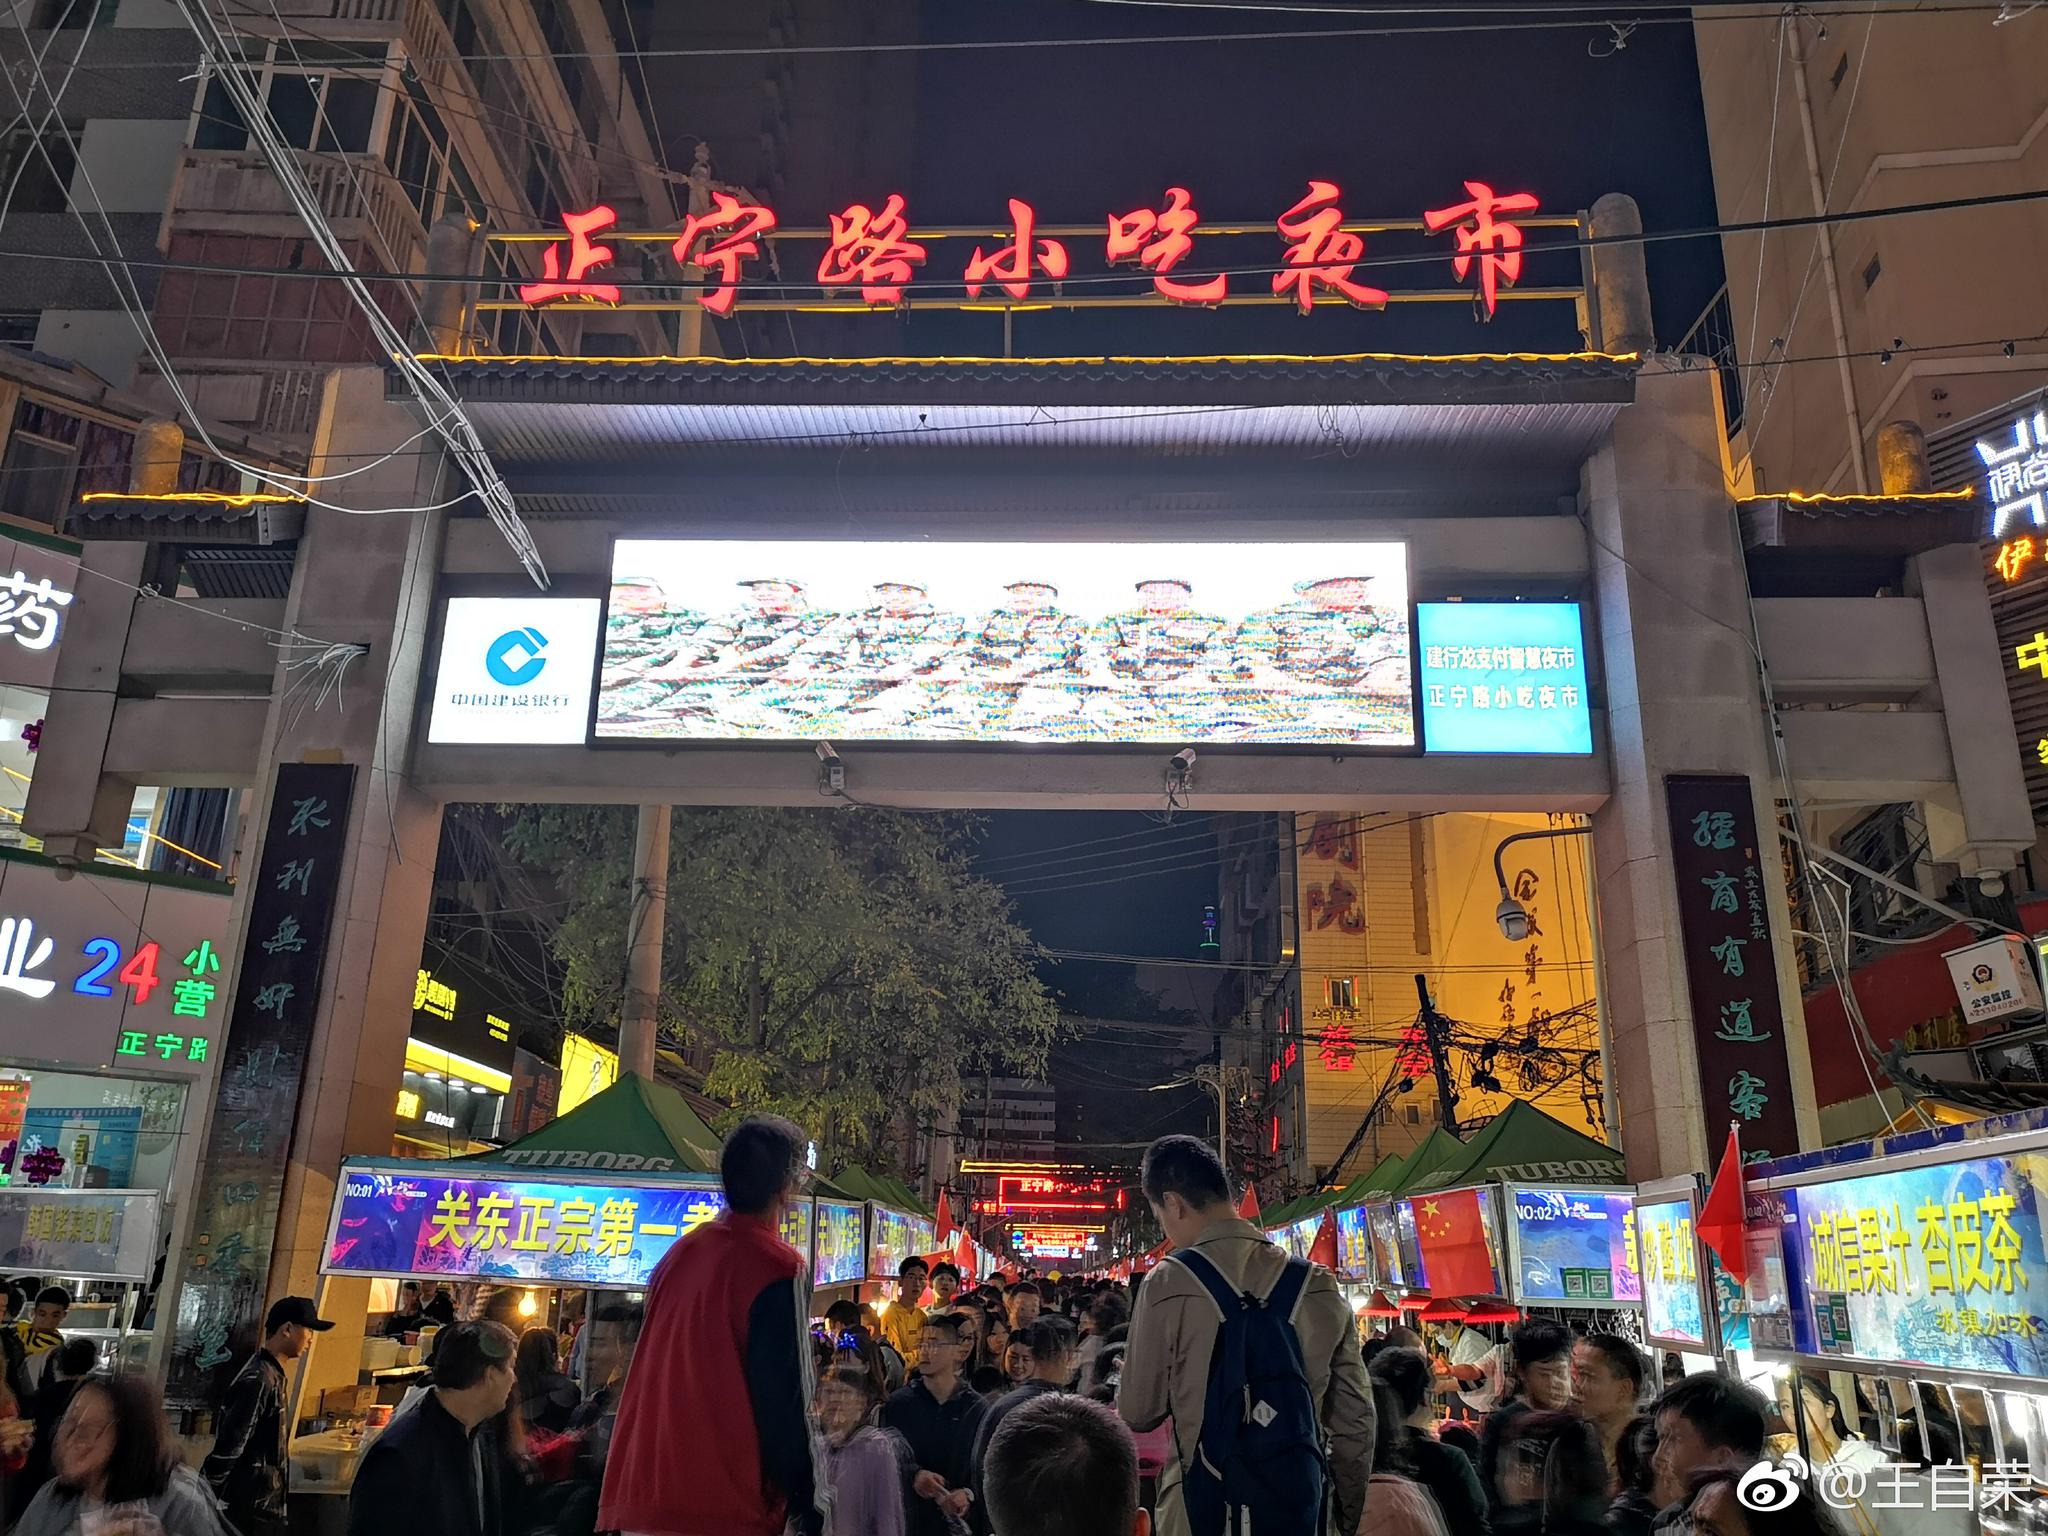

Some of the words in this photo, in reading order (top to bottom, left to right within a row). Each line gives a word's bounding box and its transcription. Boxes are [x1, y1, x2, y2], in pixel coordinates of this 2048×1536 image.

[520, 181, 1540, 317] 正宁路小吃夜市
[1426, 645, 1575, 670] 建行龙支付智慧夜市
[451, 693, 569, 707] 中国建设银行
[1428, 684, 1578, 709] 正宁路小吃夜市
[345, 1183, 373, 1198] NO:01
